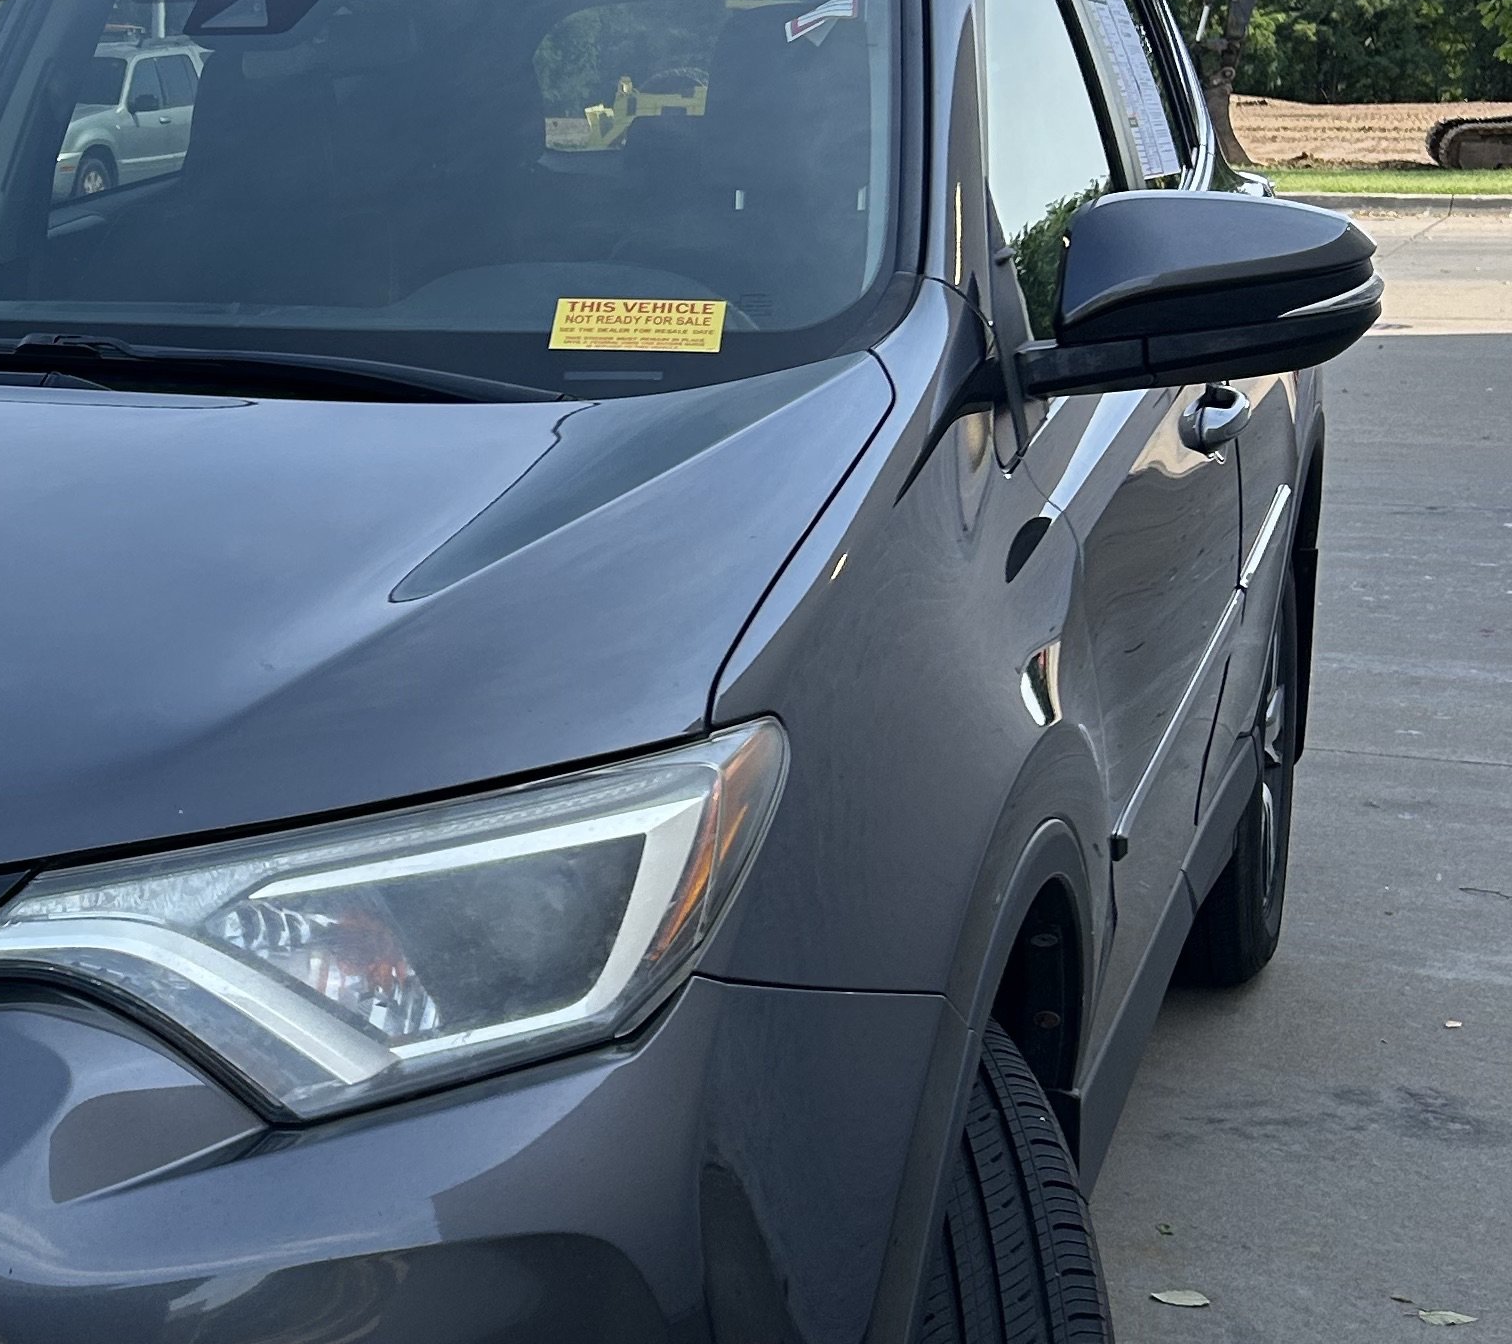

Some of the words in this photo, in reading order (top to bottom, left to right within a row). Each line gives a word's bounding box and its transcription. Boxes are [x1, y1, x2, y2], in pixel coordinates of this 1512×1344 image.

[567, 301, 616, 313] THIS
[623, 301, 715, 315] VEHICLE
[564, 314, 593, 324] NOT
[595, 315, 642, 325] READY
[644, 316, 673, 325] FOR
[676, 316, 712, 326] SALE
